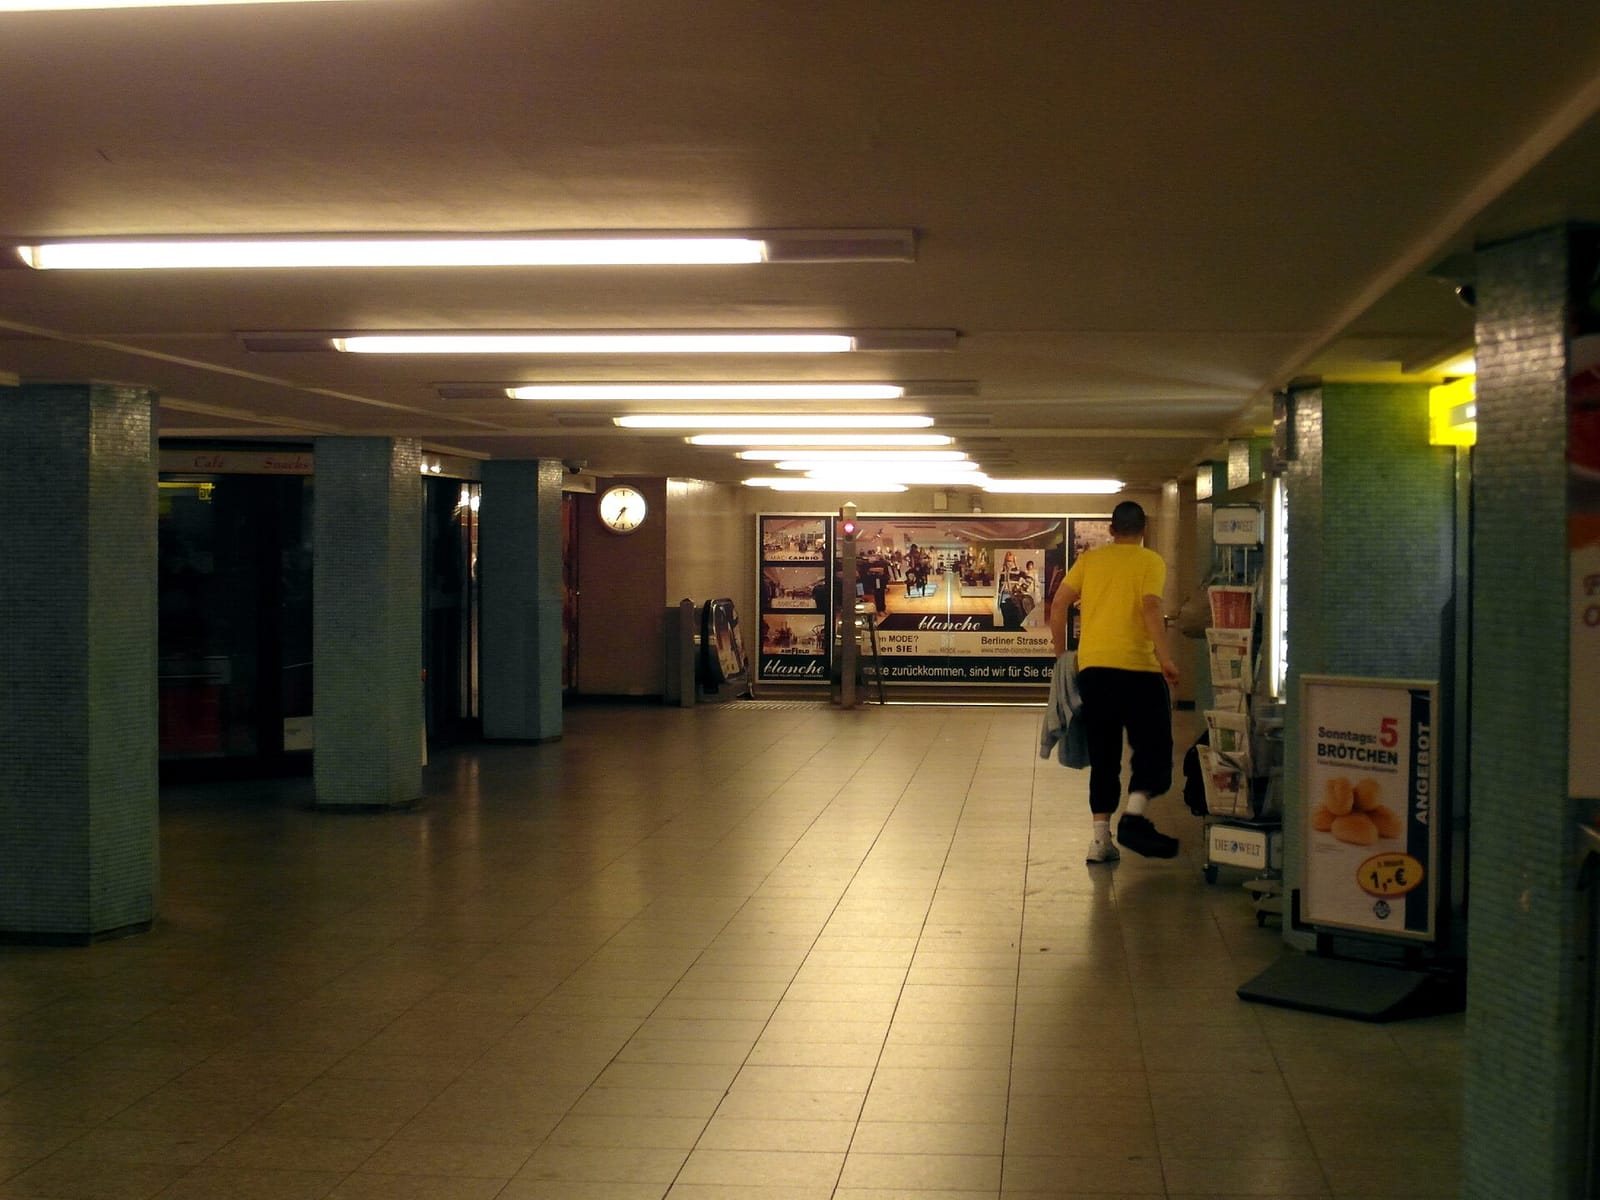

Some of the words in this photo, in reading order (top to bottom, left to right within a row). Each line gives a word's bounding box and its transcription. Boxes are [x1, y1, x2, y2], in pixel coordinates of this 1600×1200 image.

[918, 616, 981, 631] blanche
[888, 635, 919, 643] MODE?
[981, 636, 1015, 645] Berliner
[1016, 637, 1048, 646] Strasse
[764, 660, 824, 674] blanche
[891, 665, 966, 678] zurückkommen,
[969, 665, 991, 678] sind
[992, 666, 1005, 678] wir
[1008, 665, 1021, 678] für
[1023, 666, 1040, 678] Sie
[1379, 717, 1399, 748] 5
[1317, 743, 1398, 765] BRÖTCHEN
[1415, 722, 1431, 825] ANGEBOT
[1214, 838, 1229, 852] DIE
[1239, 841, 1261, 857] WELT
